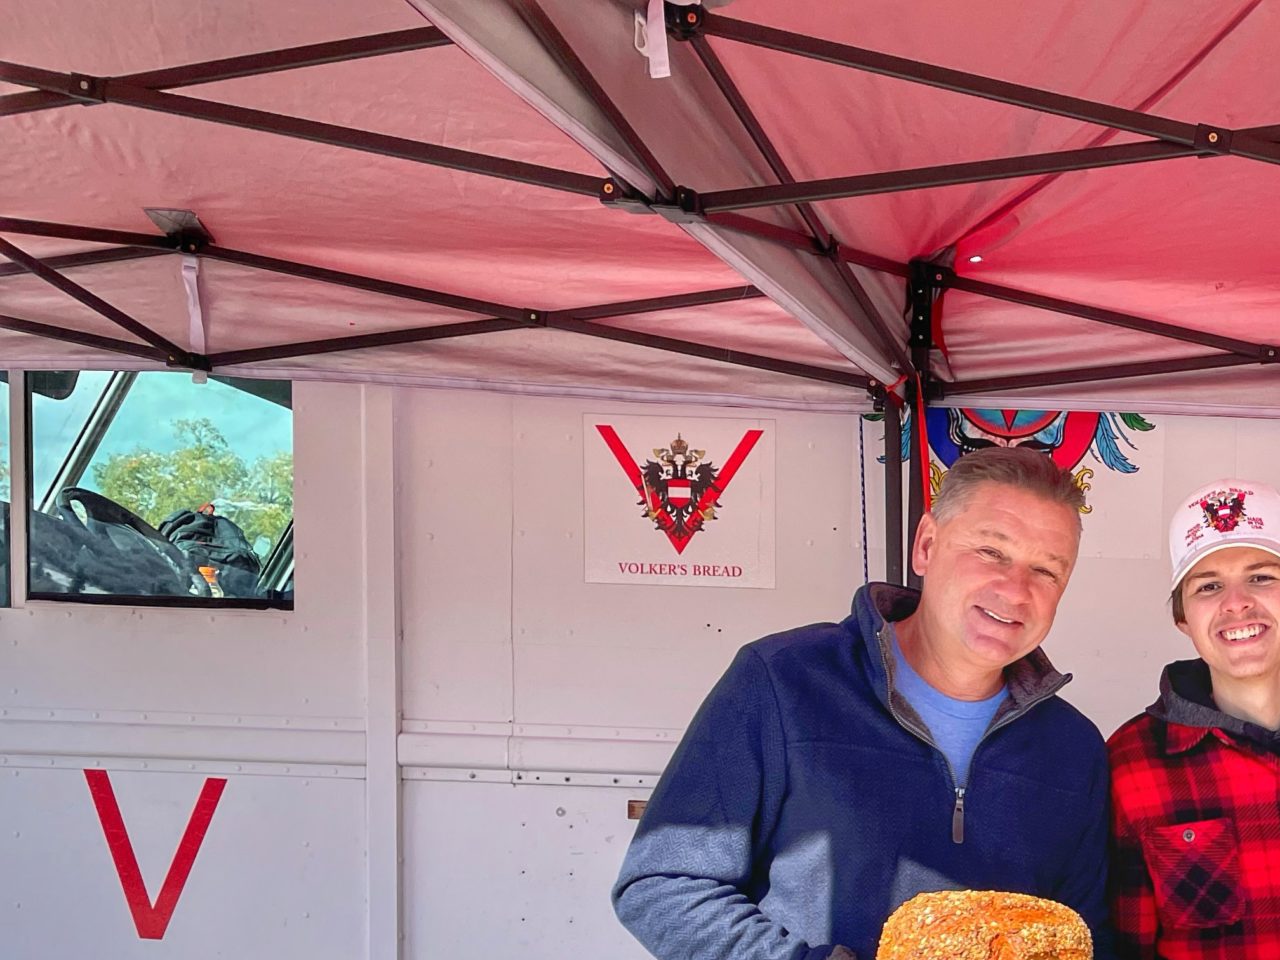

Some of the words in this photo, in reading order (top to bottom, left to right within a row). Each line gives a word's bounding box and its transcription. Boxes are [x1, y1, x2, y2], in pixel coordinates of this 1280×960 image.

[618, 562, 688, 577] VOLKER'S
[693, 564, 743, 578] BREAD
[83, 769, 228, 940] V
